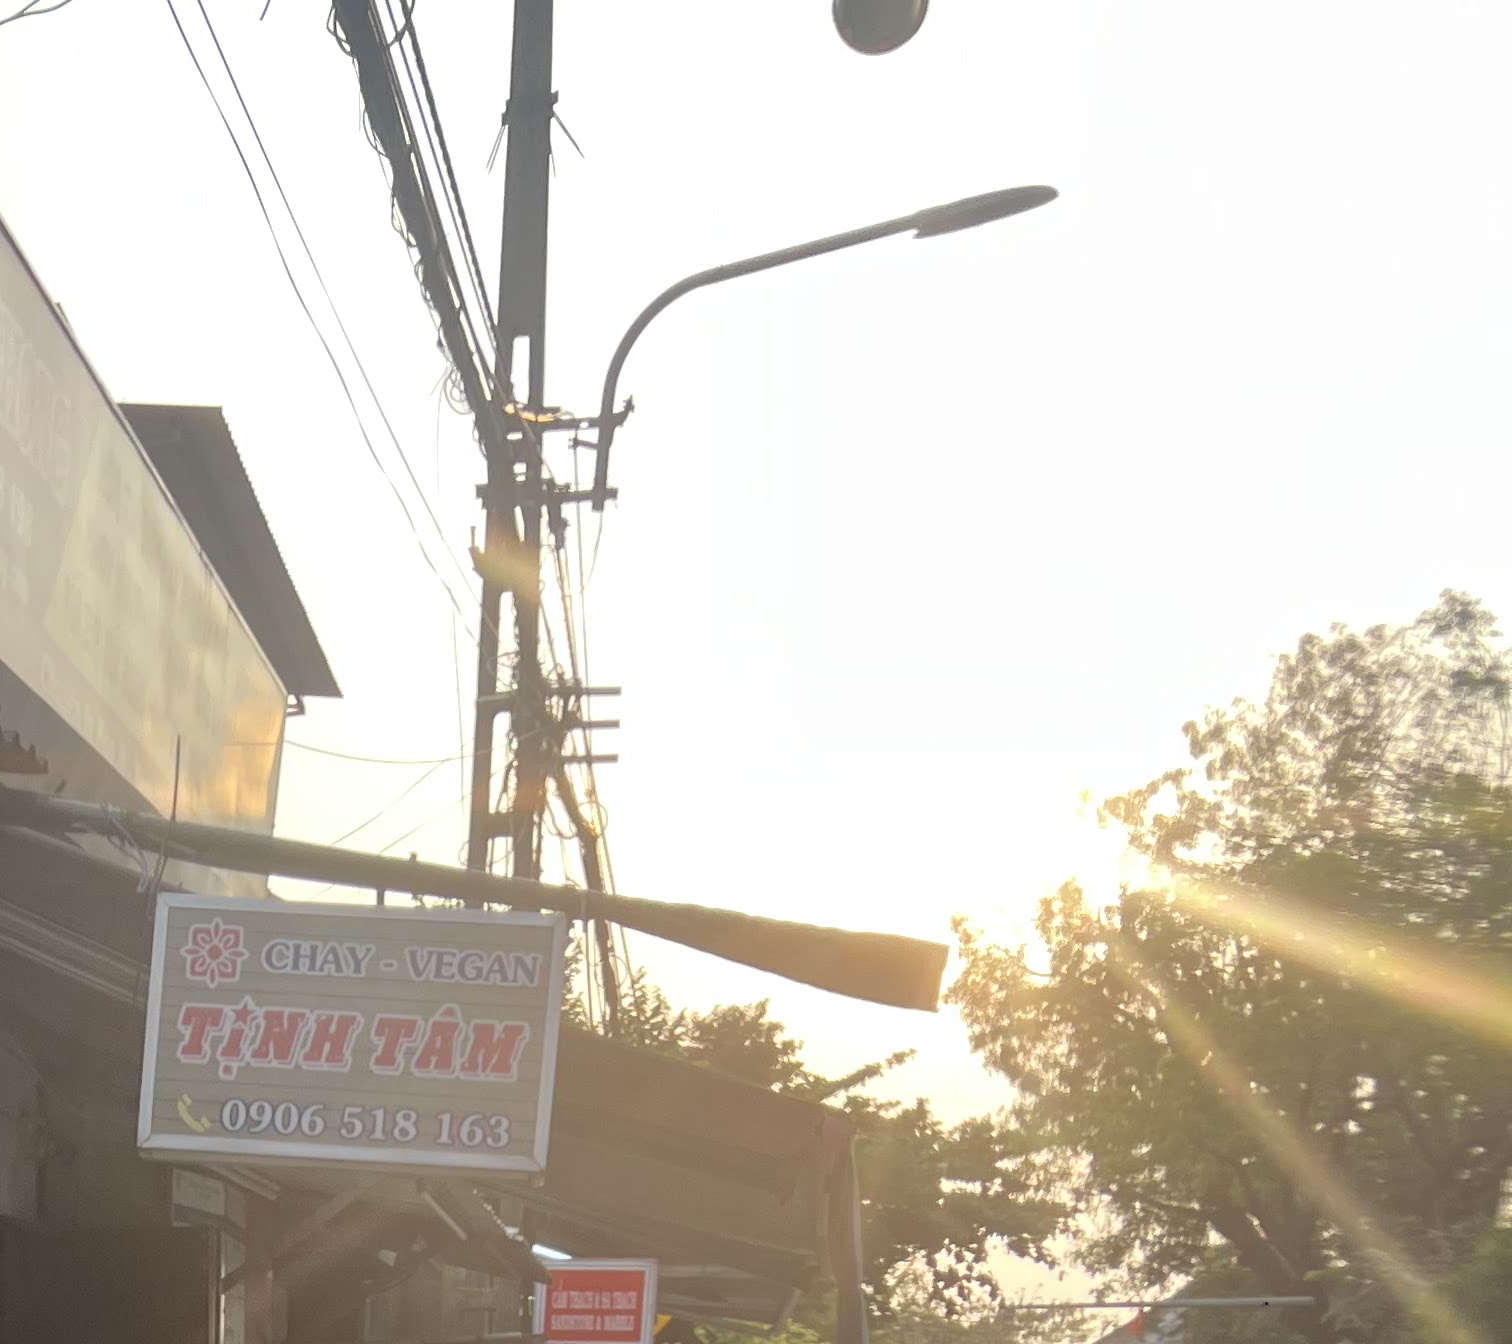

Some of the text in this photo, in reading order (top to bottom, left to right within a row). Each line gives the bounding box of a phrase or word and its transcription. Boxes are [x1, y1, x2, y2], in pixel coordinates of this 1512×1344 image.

[261, 940, 375, 977] CHAY
[407, 948, 542, 986] VEGAN
[178, 996, 530, 1081] TỊNH TÂM
[221, 1100, 511, 1148] 0906 518 163
